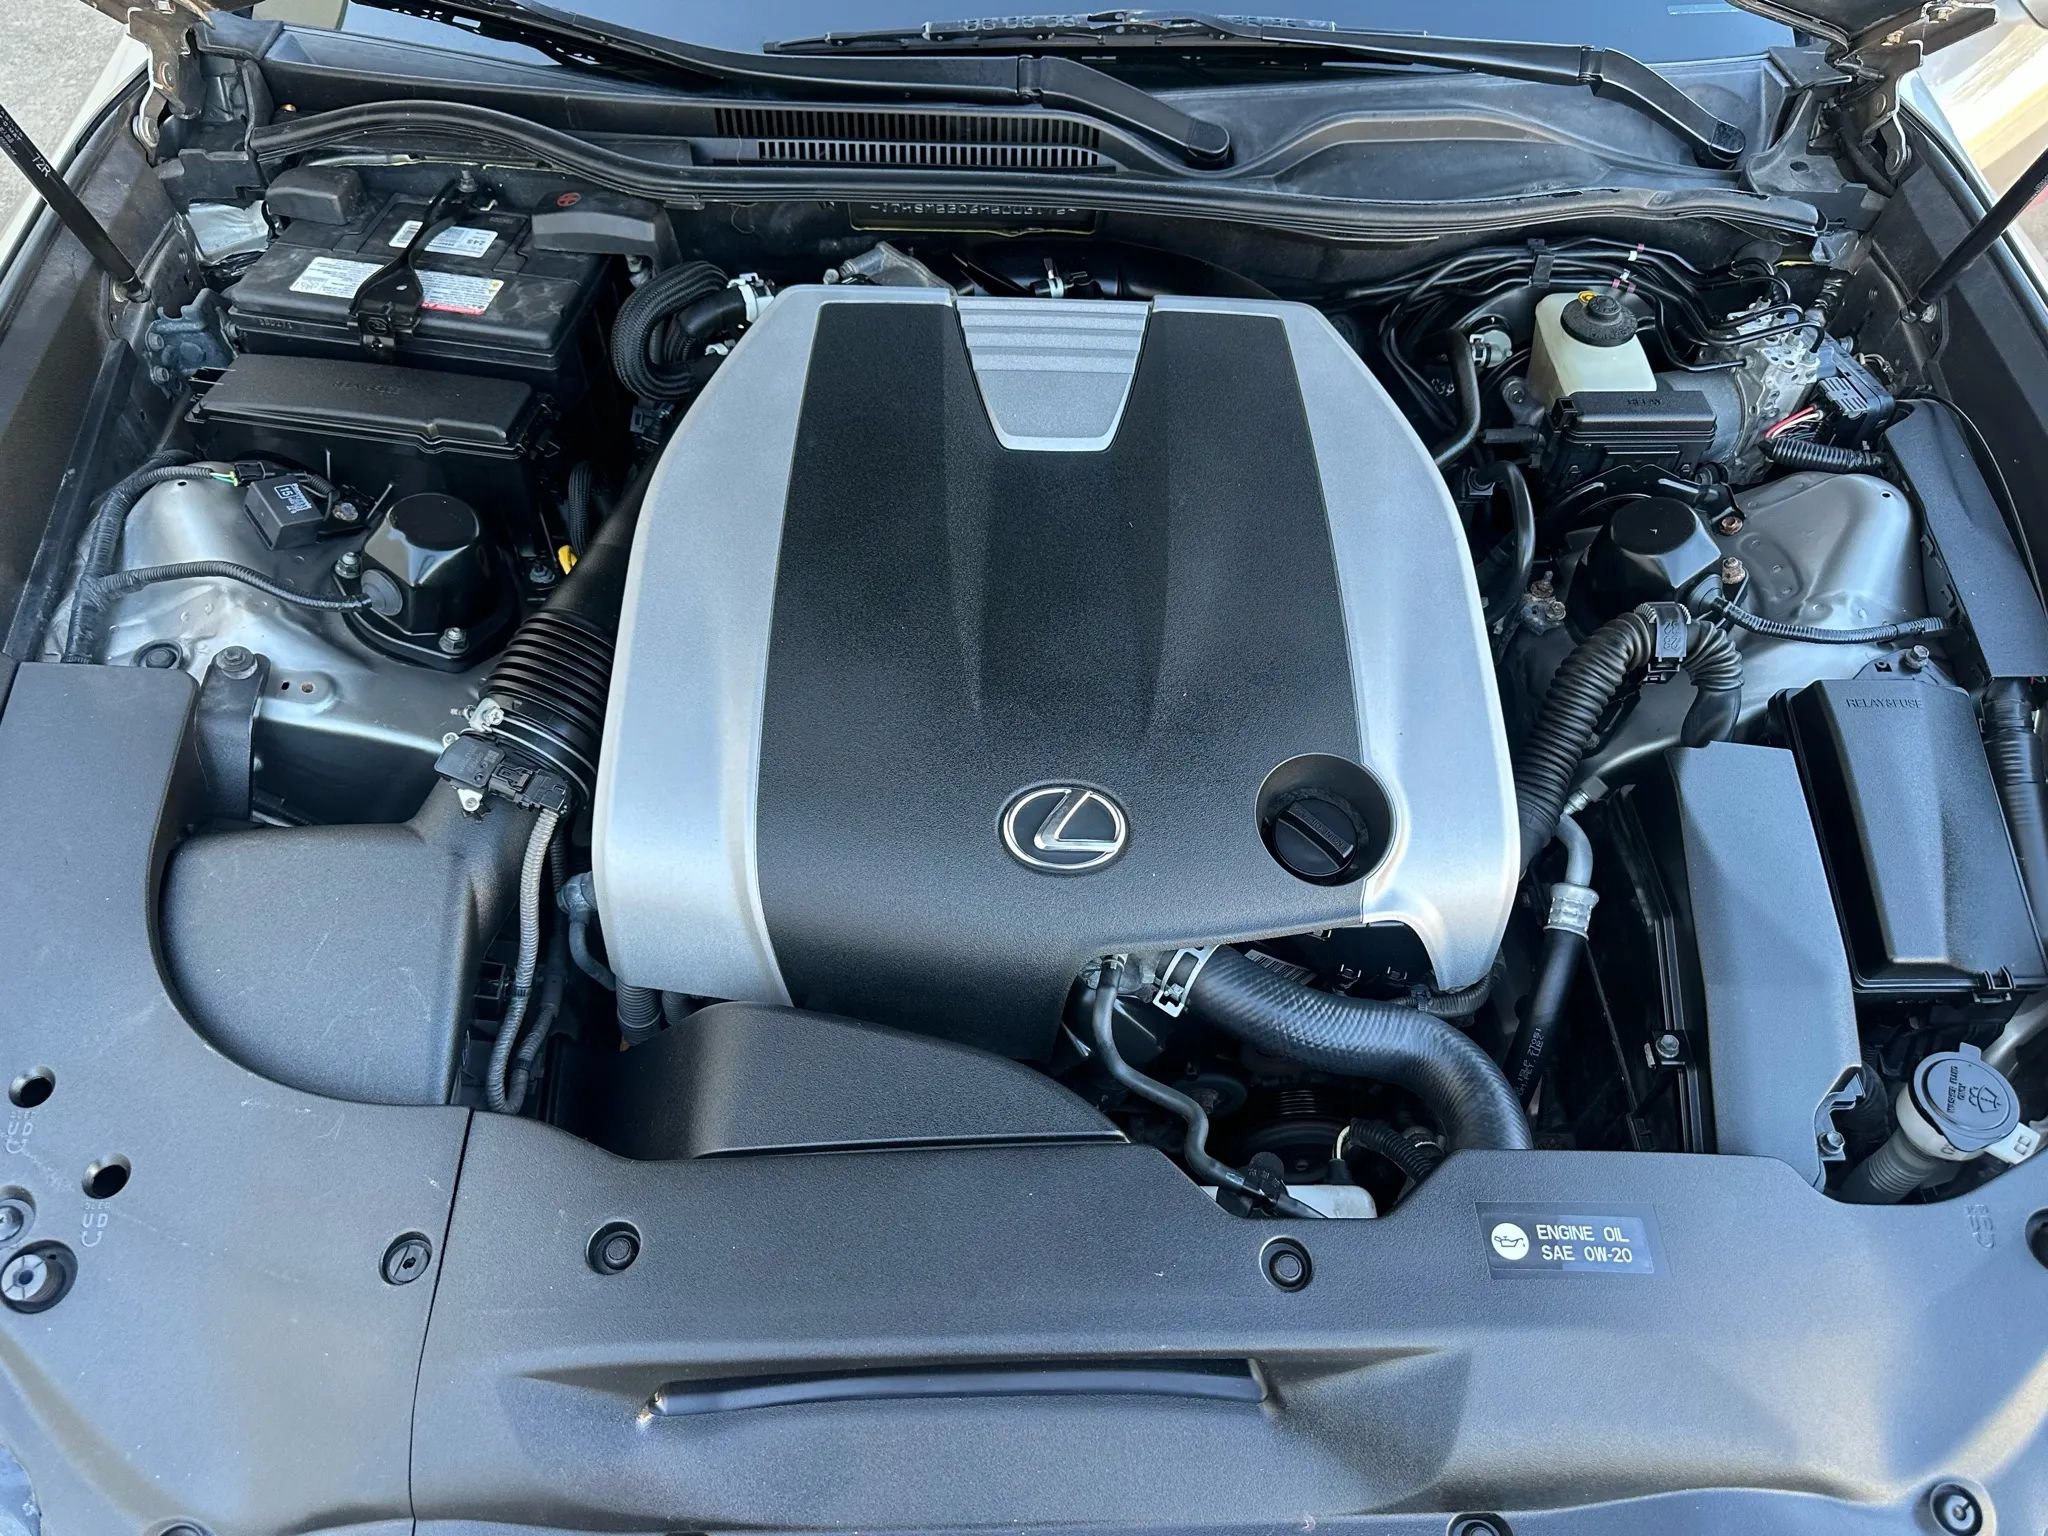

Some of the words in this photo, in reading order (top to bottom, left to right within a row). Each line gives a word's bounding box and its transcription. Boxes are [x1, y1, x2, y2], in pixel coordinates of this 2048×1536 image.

[32, 152, 51, 178] 72R
[280, 487, 294, 497] 15
[82, 1213, 94, 1228] U
[97, 1213, 109, 1228] D
[1536, 1224, 1595, 1242] ENGINE
[1603, 1226, 1630, 1243] OIL
[1541, 1245, 1576, 1261] SAE
[1584, 1246, 1633, 1263] 0W-20
